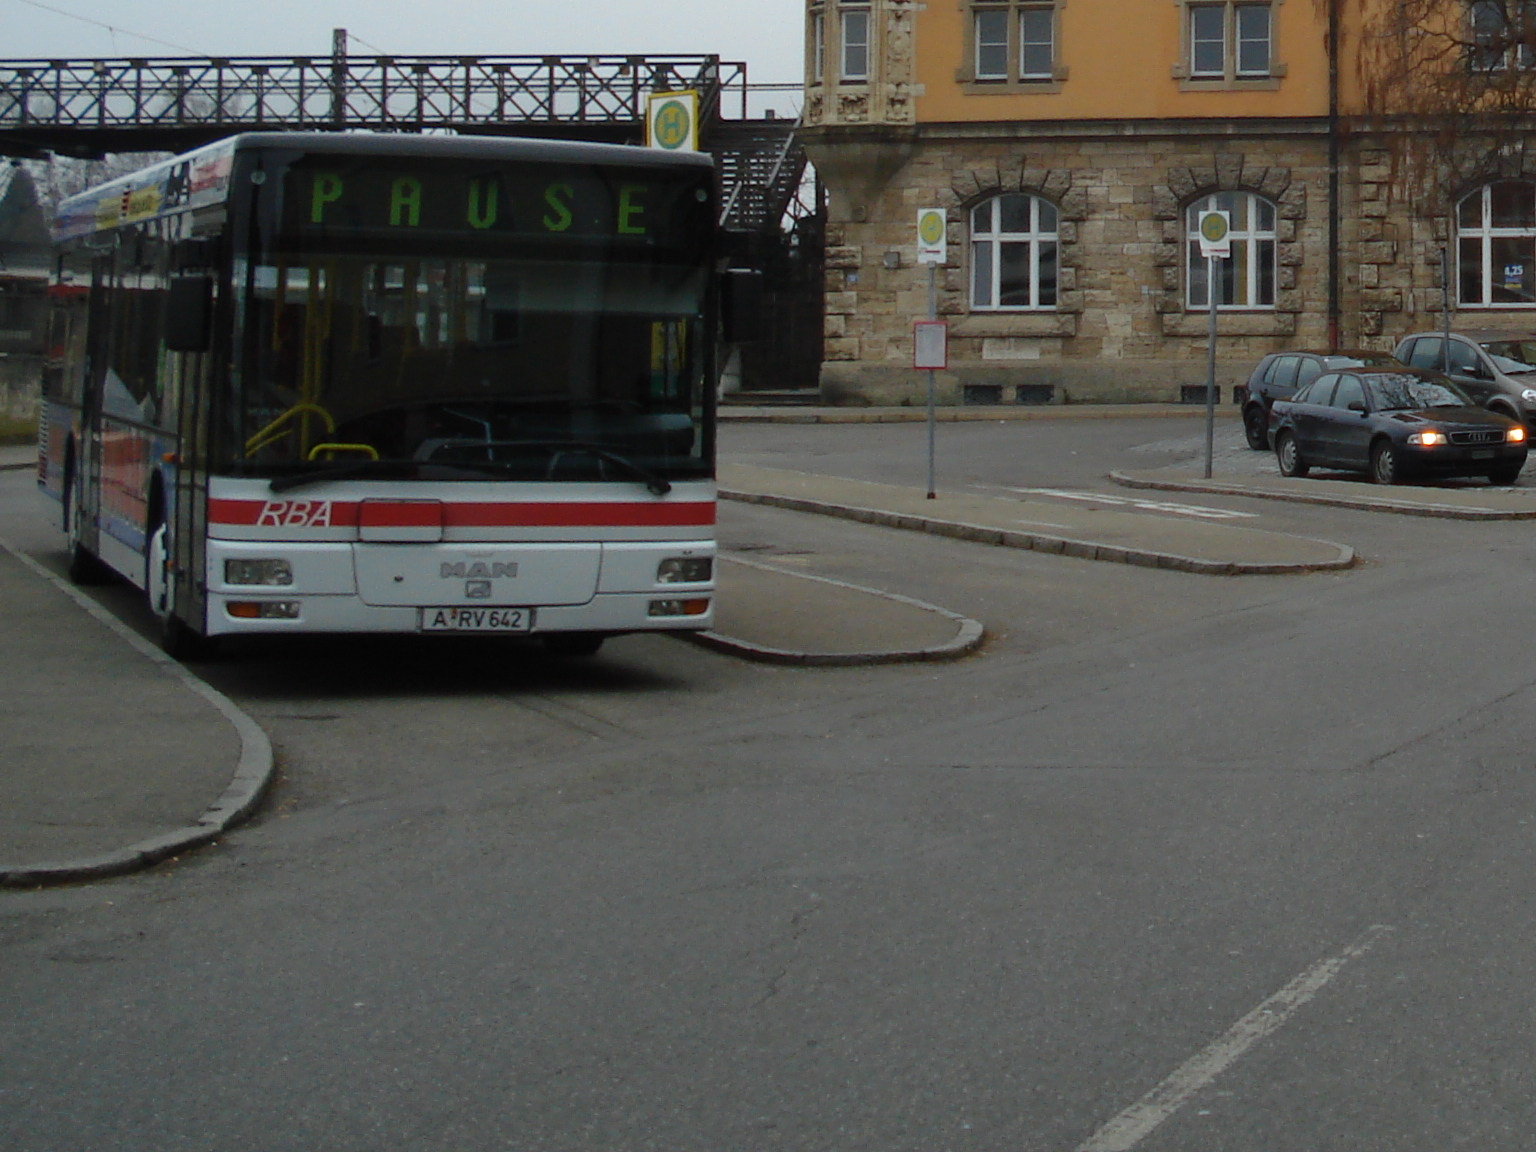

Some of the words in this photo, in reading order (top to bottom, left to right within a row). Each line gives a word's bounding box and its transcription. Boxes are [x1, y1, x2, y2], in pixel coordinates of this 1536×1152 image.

[312, 174, 647, 234] PAUSE
[257, 500, 332, 527] RBA
[440, 562, 518, 578] MAN
[489, 611, 522, 628] 642
